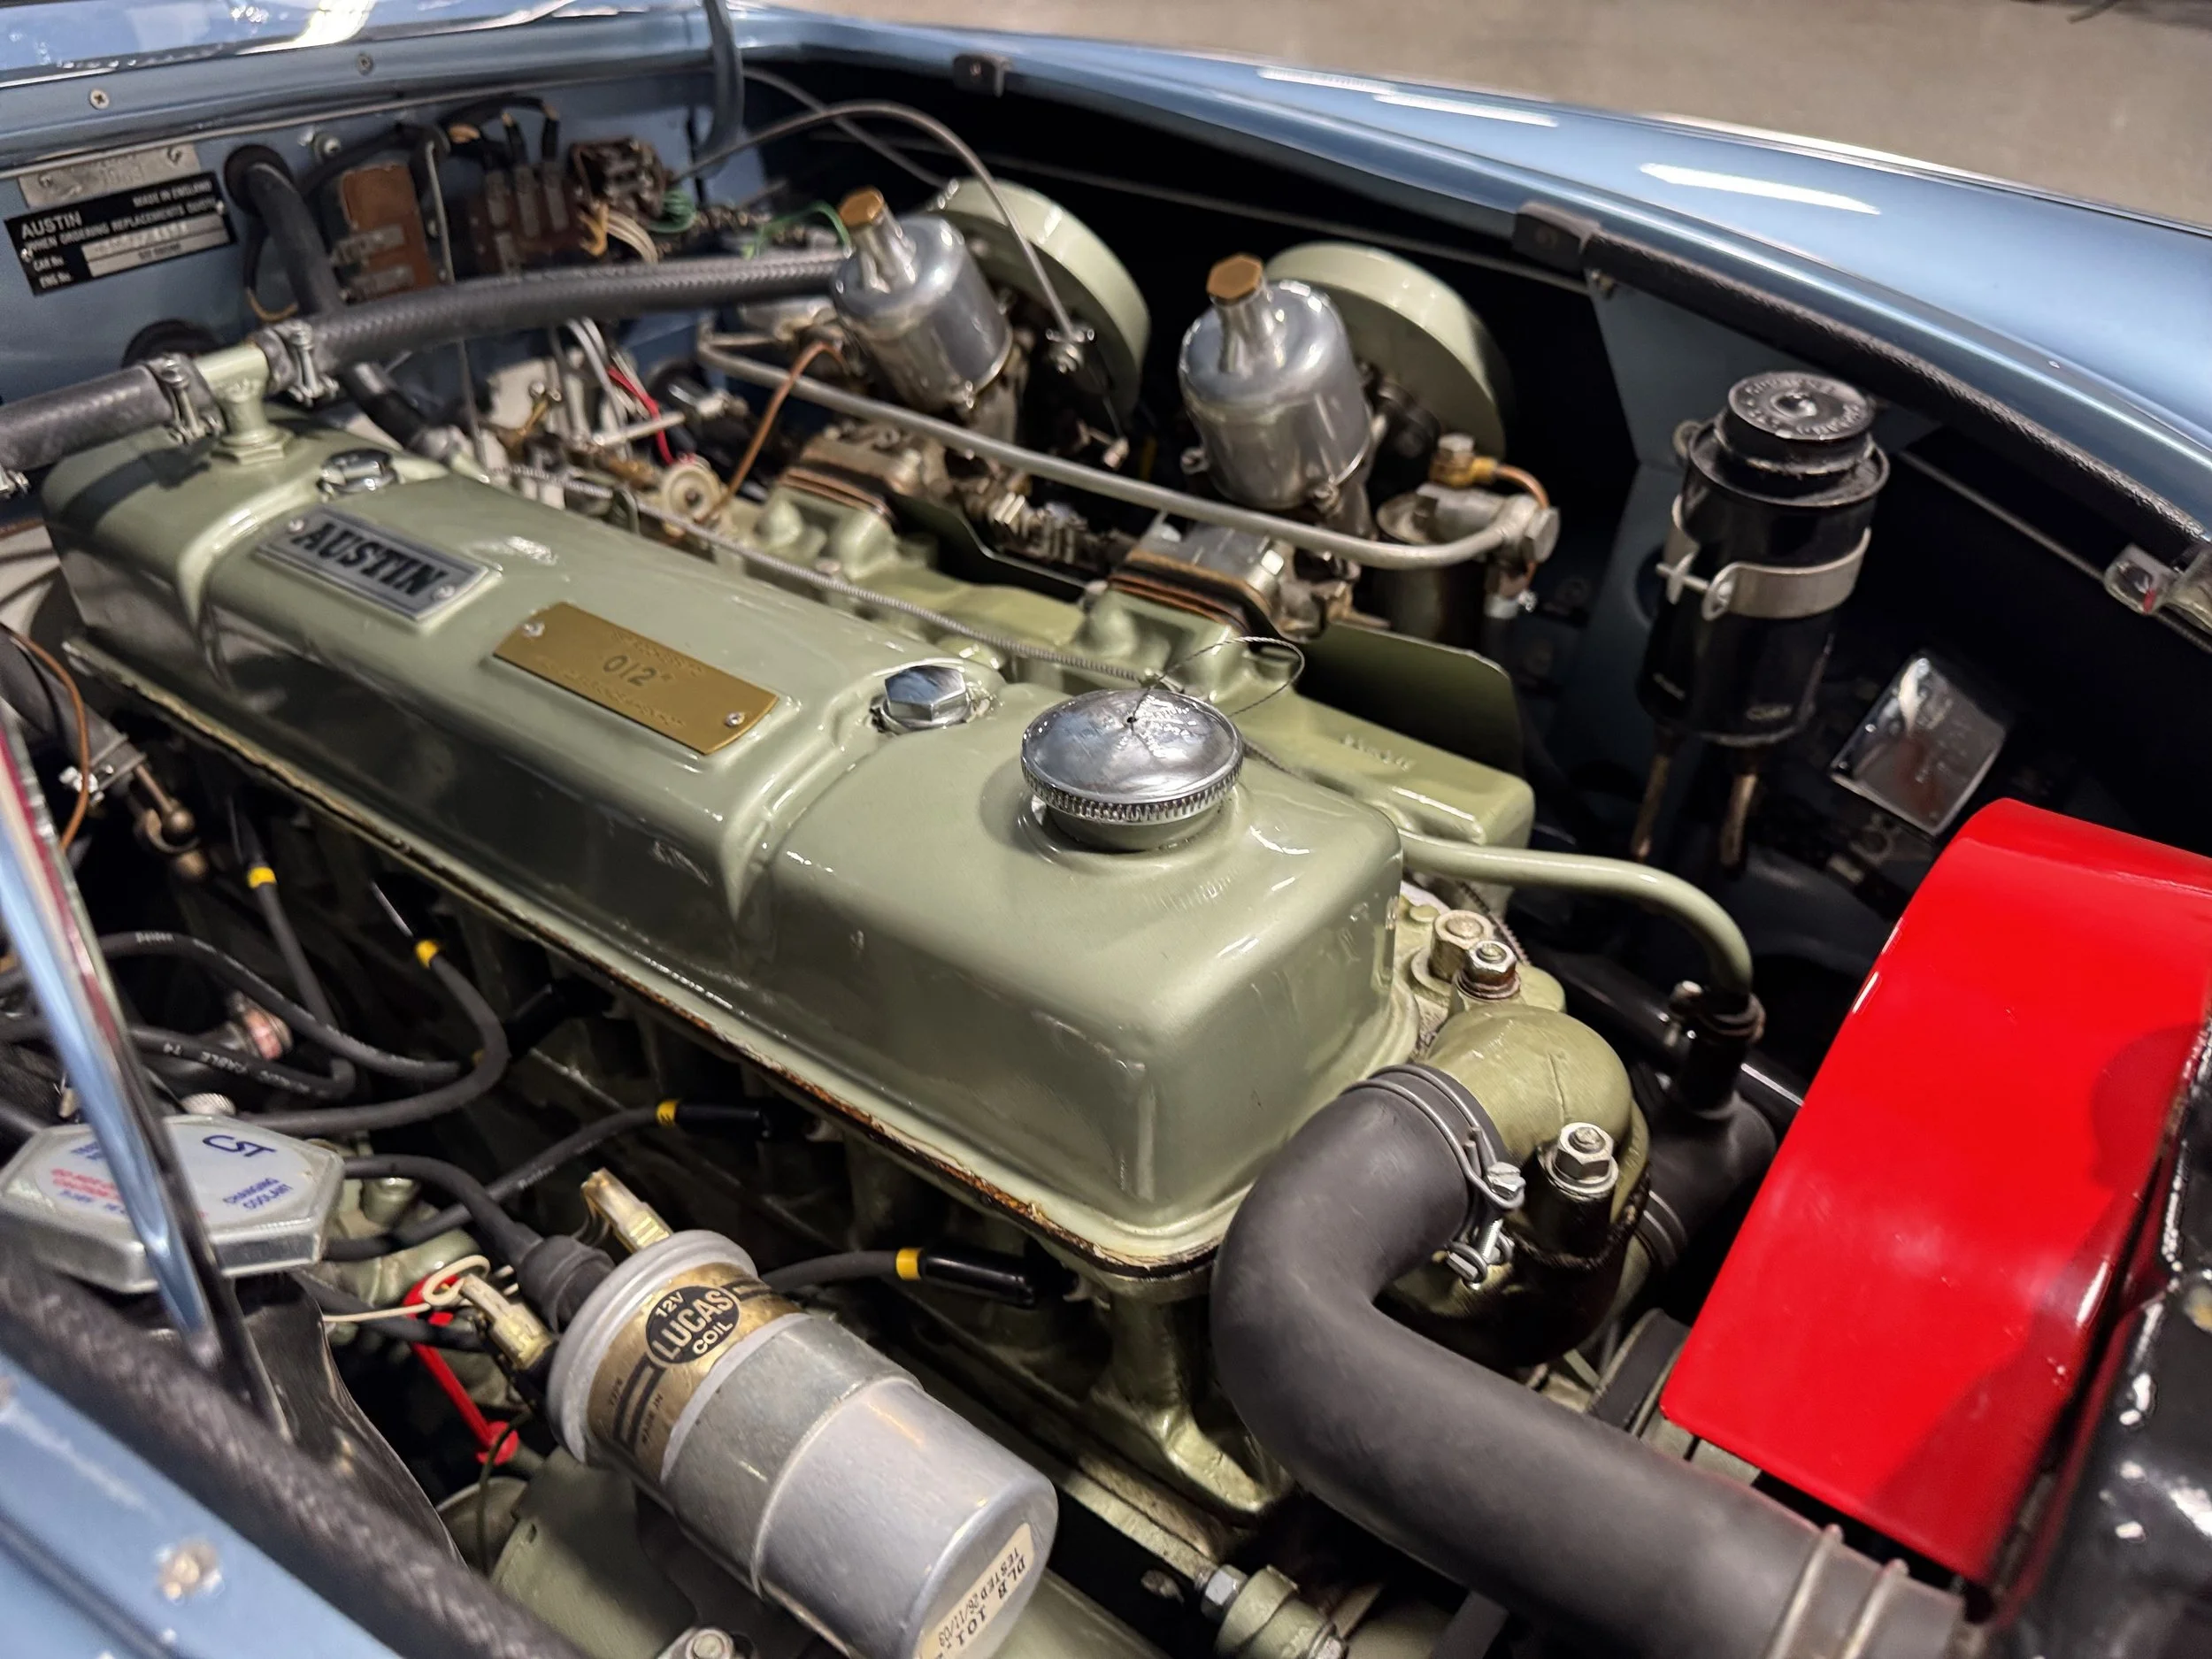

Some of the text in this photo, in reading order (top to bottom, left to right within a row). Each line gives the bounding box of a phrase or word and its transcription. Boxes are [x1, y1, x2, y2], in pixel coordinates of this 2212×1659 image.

[21, 211, 82, 240] AUSTIN
[292, 524, 448, 595] AUSTIN
[655, 1290, 684, 1319] 12V
[652, 1290, 734, 1361] LUCAS
[692, 1320, 733, 1356] COIL
